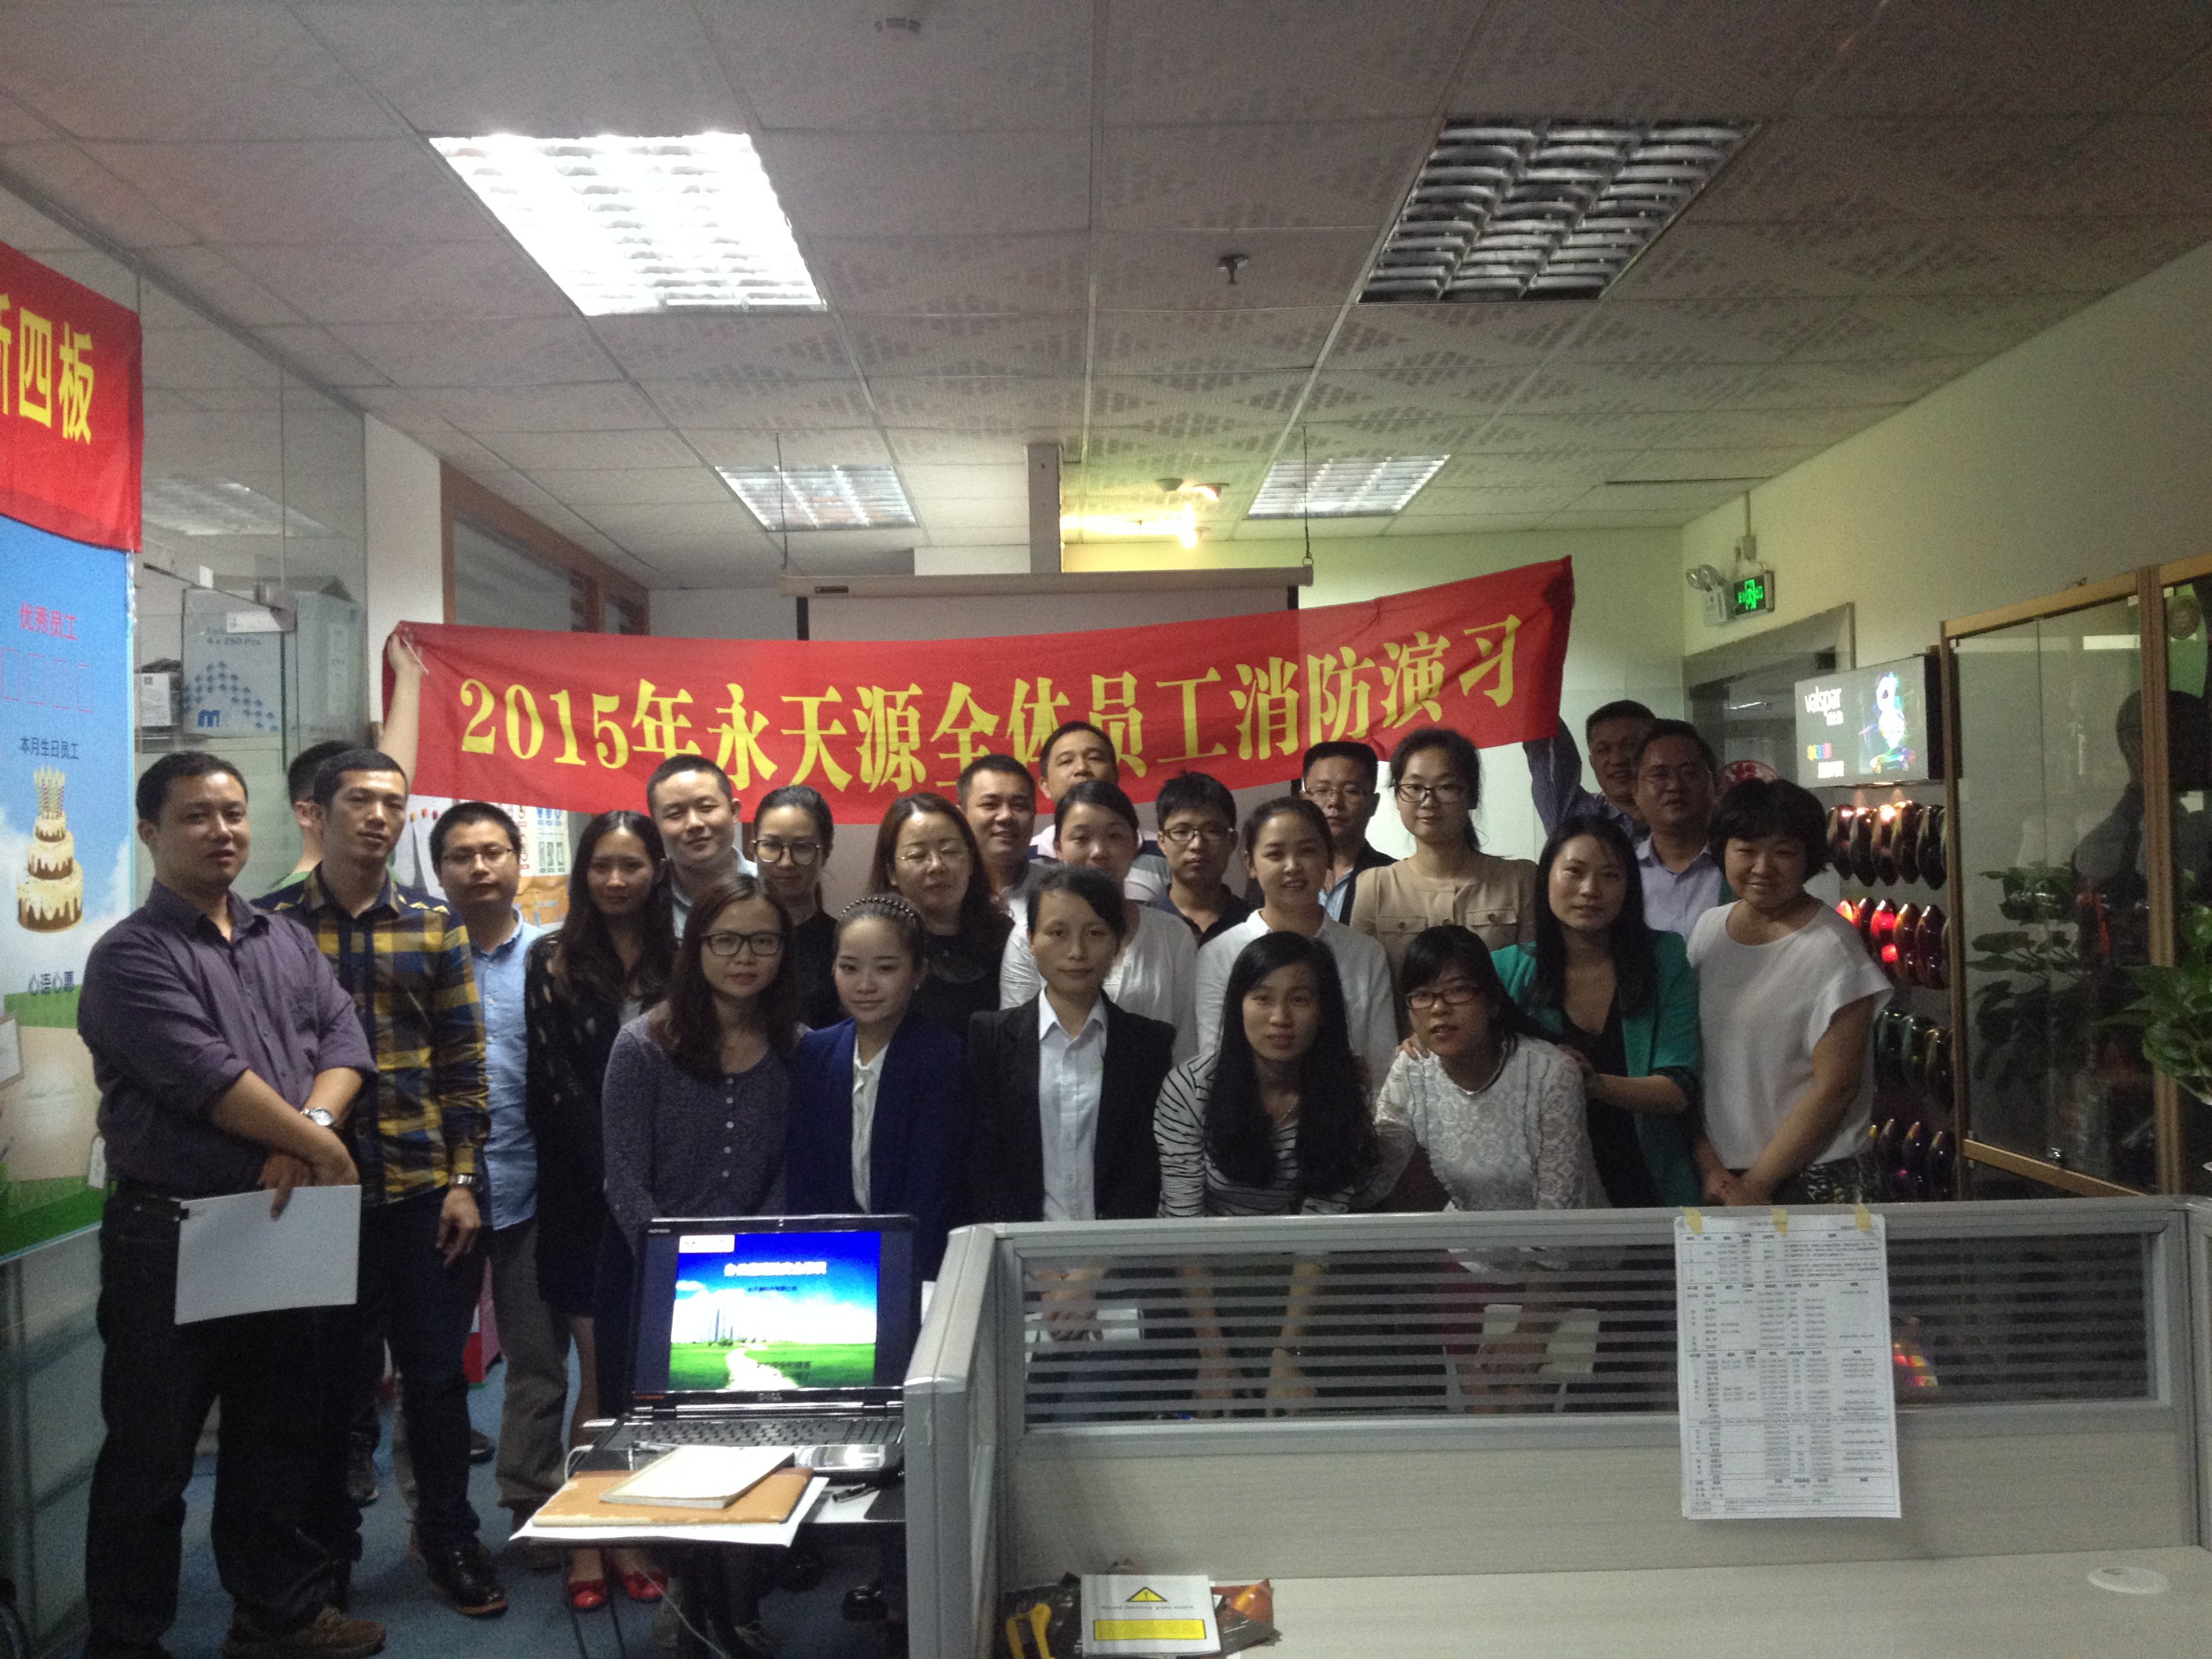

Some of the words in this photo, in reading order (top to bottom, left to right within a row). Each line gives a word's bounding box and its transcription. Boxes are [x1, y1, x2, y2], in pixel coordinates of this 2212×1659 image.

[18, 601, 79, 641] 优秀员工
[459, 613, 1522, 793] 2015年永天源全体员工消防演习
[1804, 686, 1842, 716] valspar
[20, 736, 80, 760] 本月生日员工
